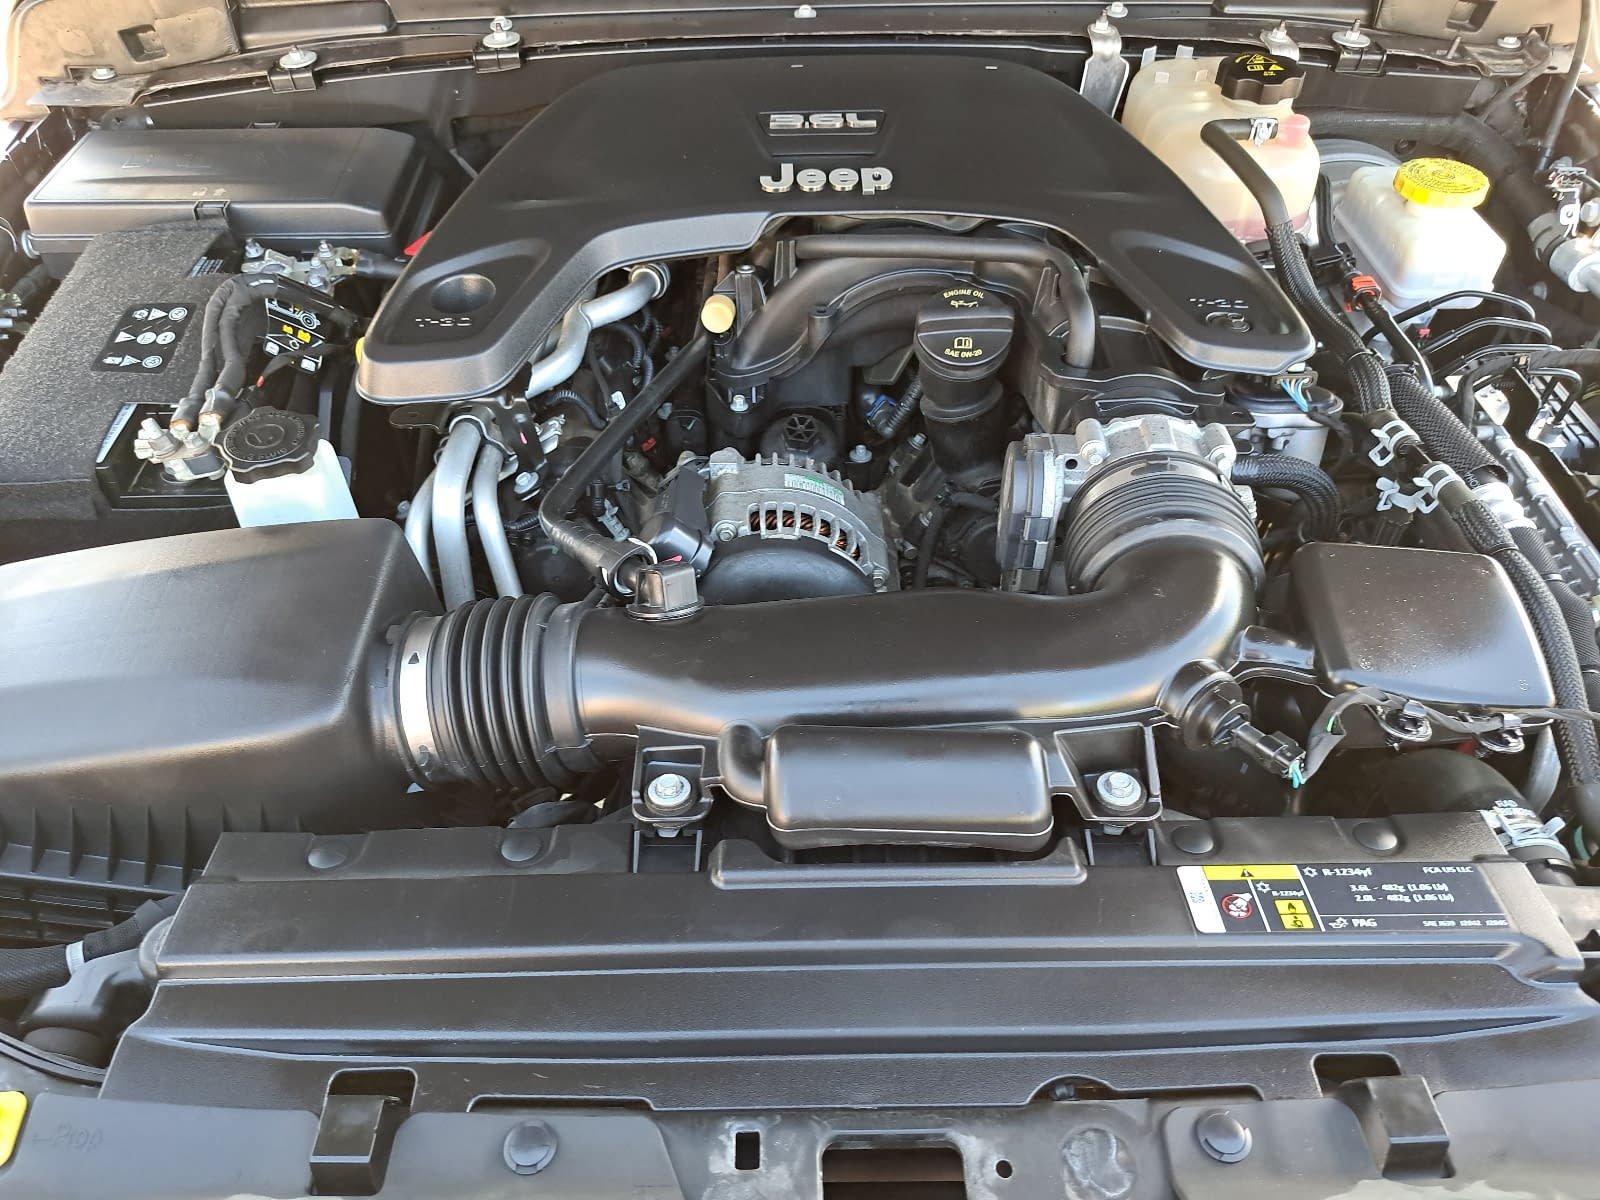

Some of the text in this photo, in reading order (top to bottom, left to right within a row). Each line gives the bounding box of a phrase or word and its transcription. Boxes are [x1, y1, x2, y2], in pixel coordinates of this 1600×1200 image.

[769, 113, 877, 129] 3.6L
[759, 163, 893, 195] Jeep
[943, 289, 985, 299] ENGINE OIL
[944, 348, 960, 357] SAE
[1321, 867, 1373, 878] R-1234yf
[1422, 866, 1442, 874] FCA
[1351, 918, 1378, 927] PAG
